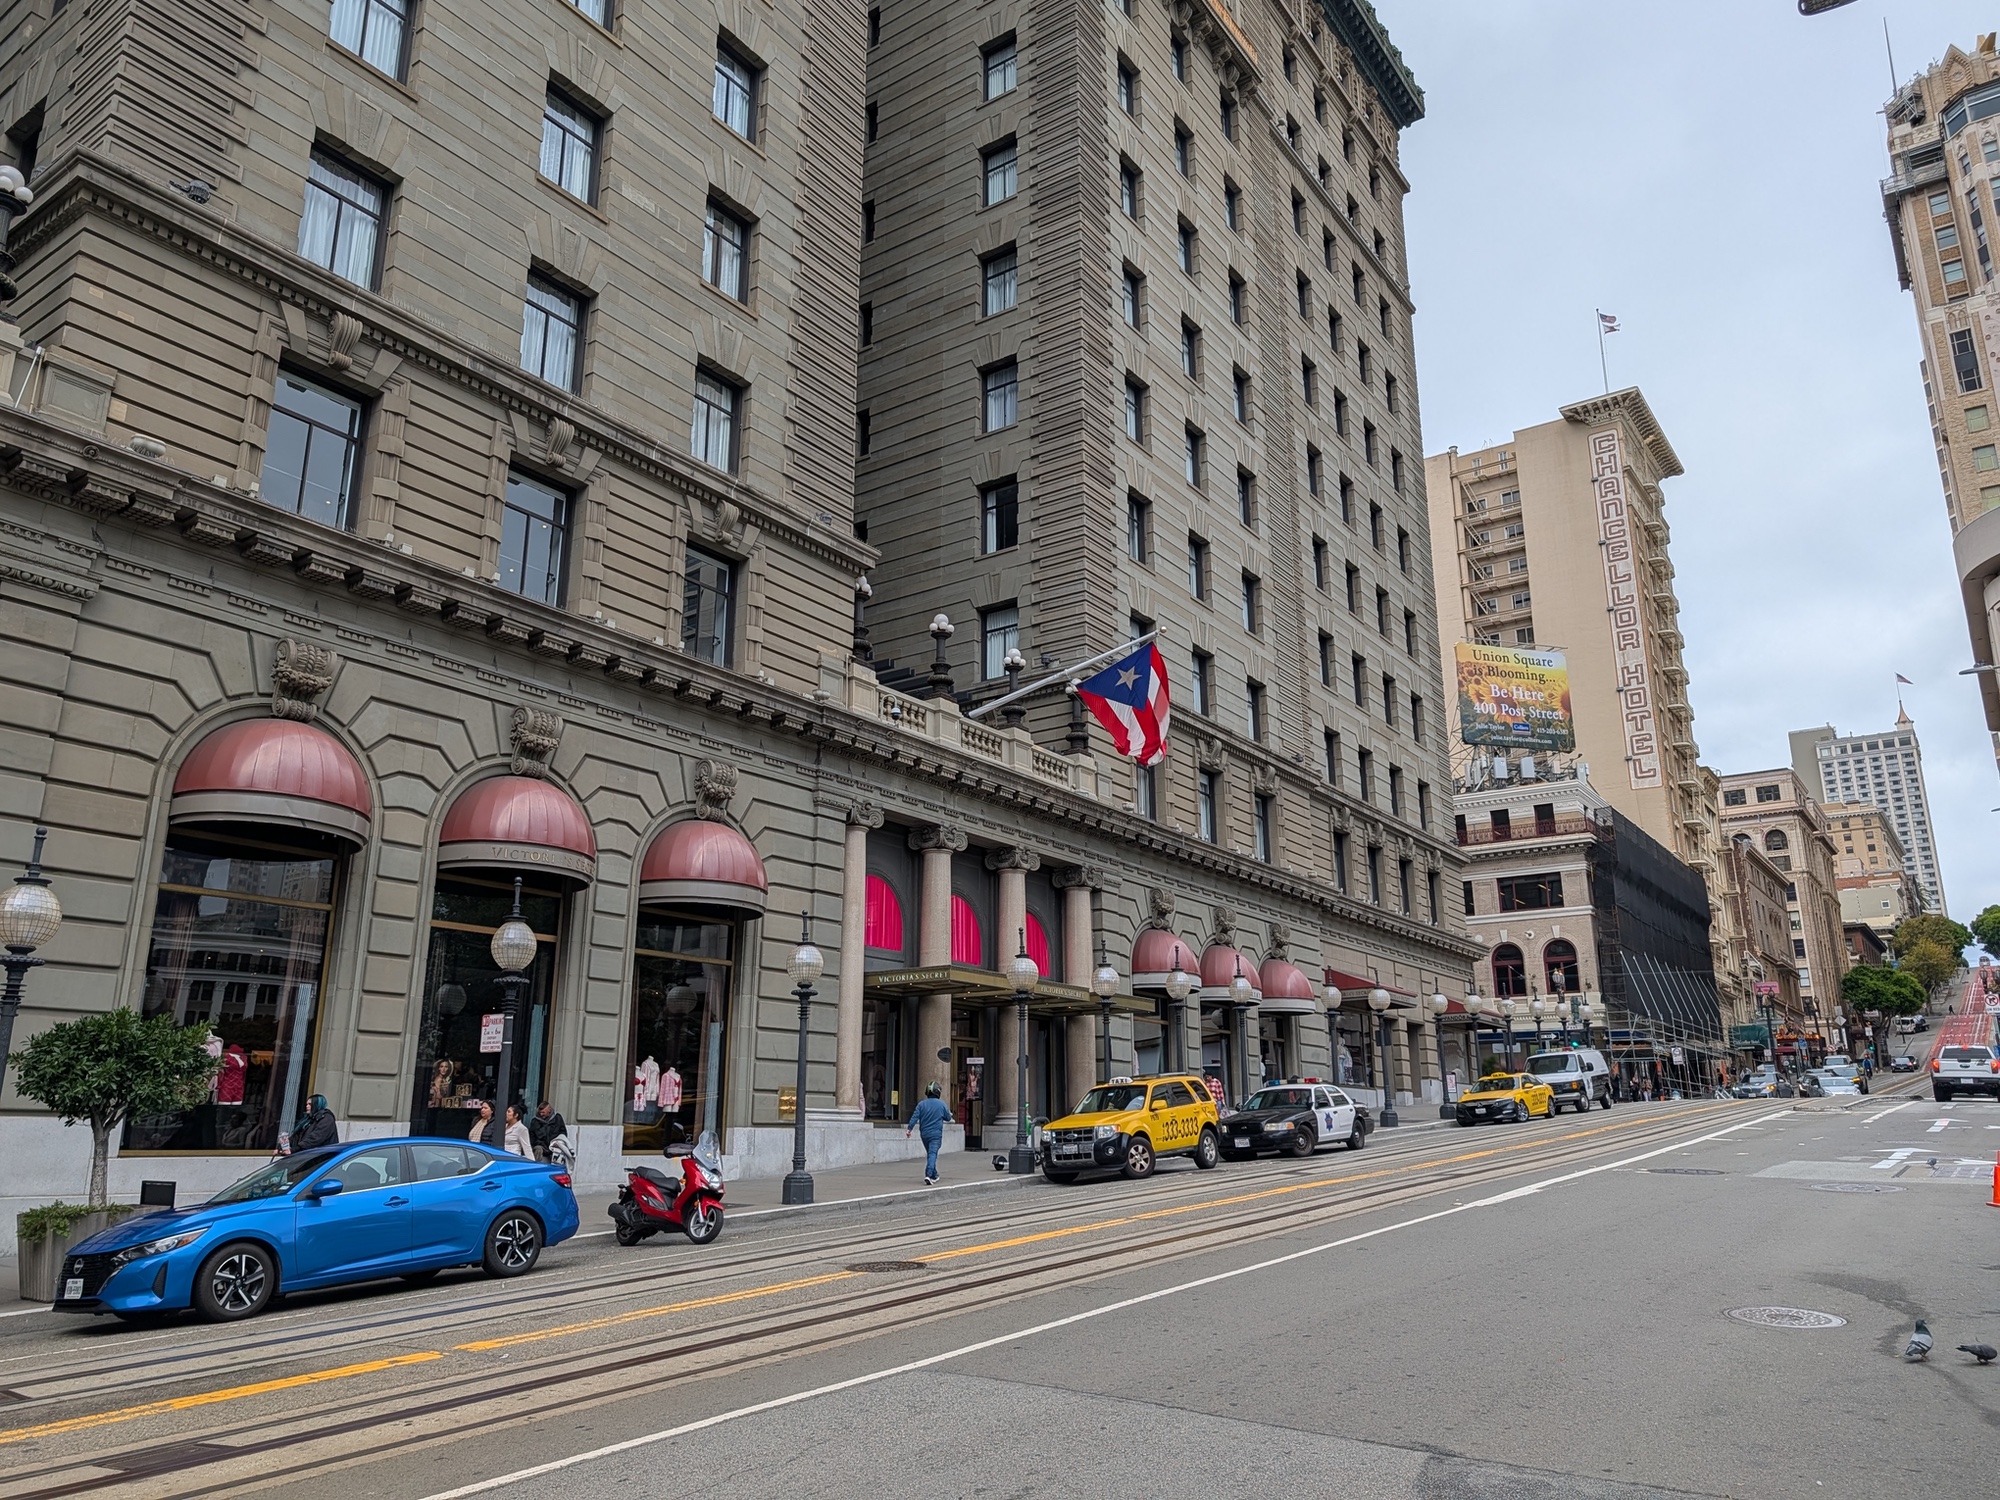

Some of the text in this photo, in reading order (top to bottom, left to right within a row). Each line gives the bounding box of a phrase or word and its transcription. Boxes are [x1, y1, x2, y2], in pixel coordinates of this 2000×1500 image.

[1593, 433, 1657, 779] CHANCELLOR HOTEL
[1472, 649, 1554, 668] Union Square
[1473, 665, 1556, 684] is Blooming...
[1490, 683, 1545, 701] Be Here
[1473, 702, 1564, 721] 400 Post Street
[879, 971, 947, 983] VICTORIA'S SECRET
[1165, 1116, 1199, 1142] 333-3333
